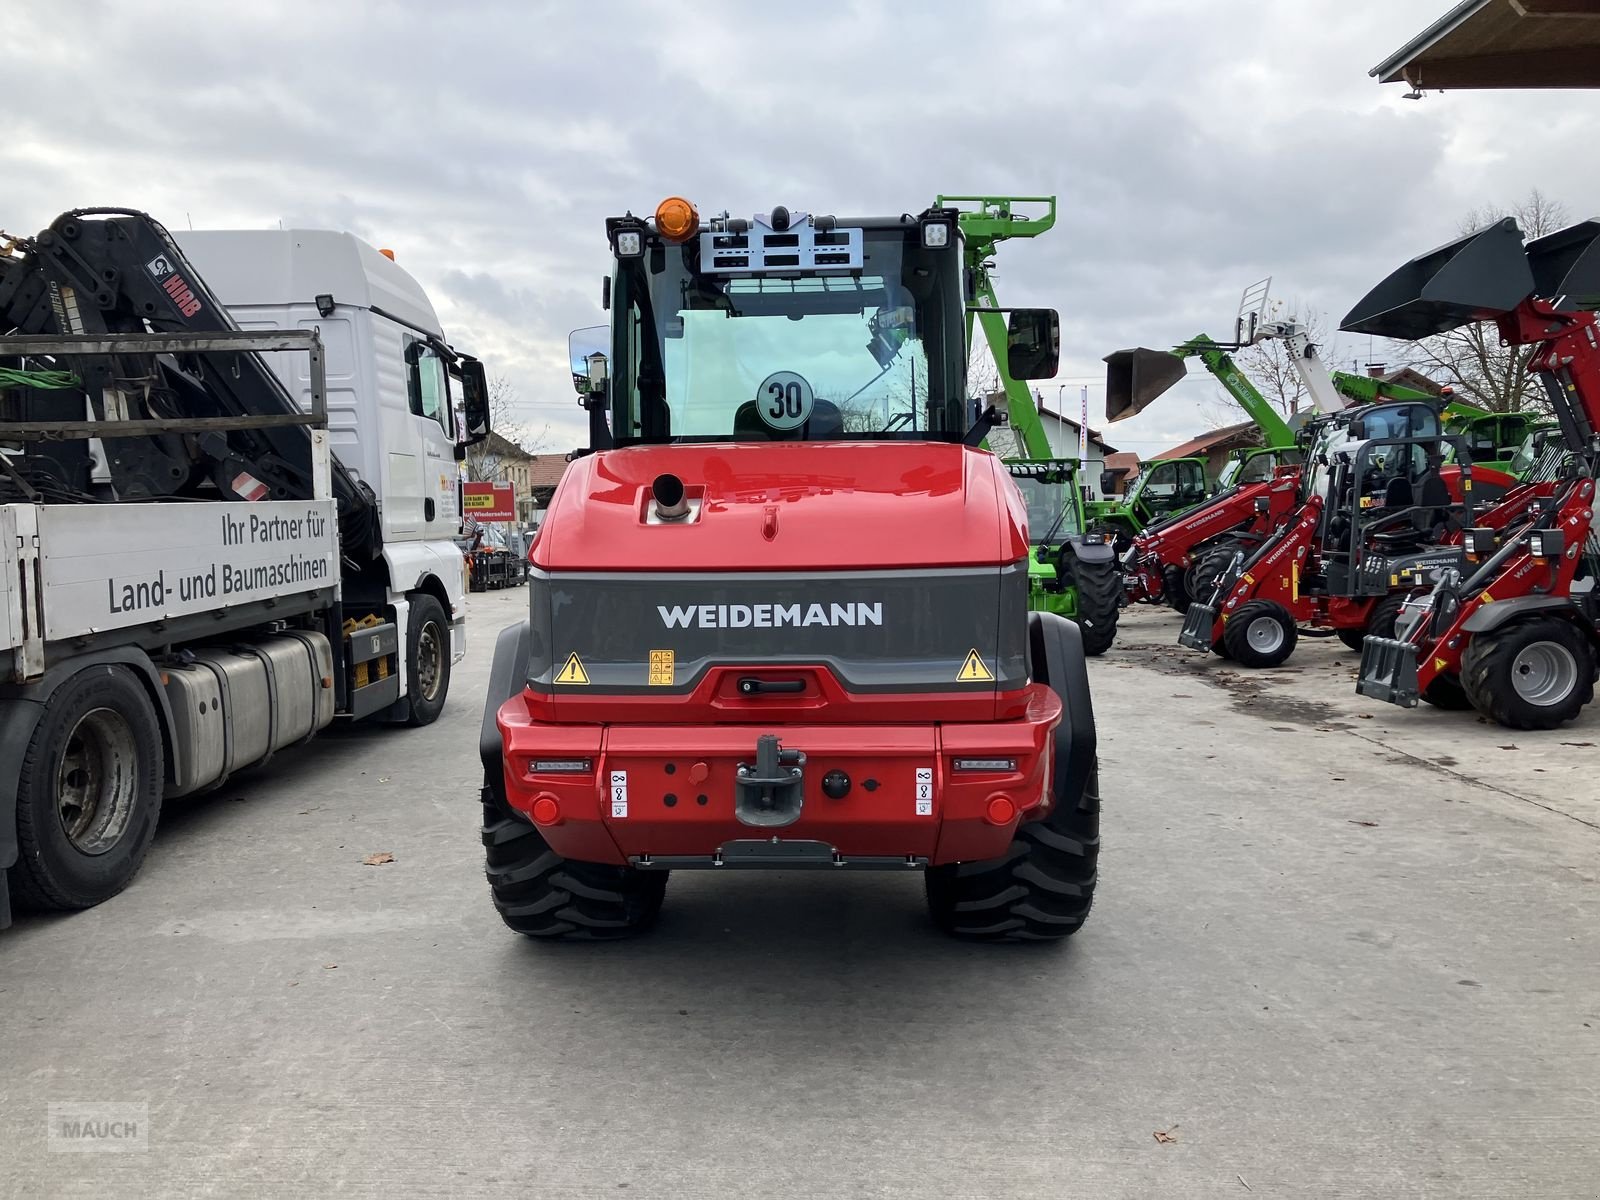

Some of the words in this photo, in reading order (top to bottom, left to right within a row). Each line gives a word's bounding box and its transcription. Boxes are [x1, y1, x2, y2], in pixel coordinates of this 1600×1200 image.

[162, 273, 202, 317] HIAB
[768, 381, 802, 419] 30
[222, 513, 245, 546] Ihr
[250, 514, 303, 543] Partner
[306, 510, 325, 538] für
[1186, 508, 1225, 530] WEIDEMANN
[1266, 533, 1300, 565] WEIDEMANN
[1415, 557, 1458, 565] WEIDEMANN
[108, 570, 172, 614] Land-
[180, 563, 216, 601] und
[222, 553, 327, 594] Baumaschinen
[656, 602, 883, 629] WEIDEMANN
